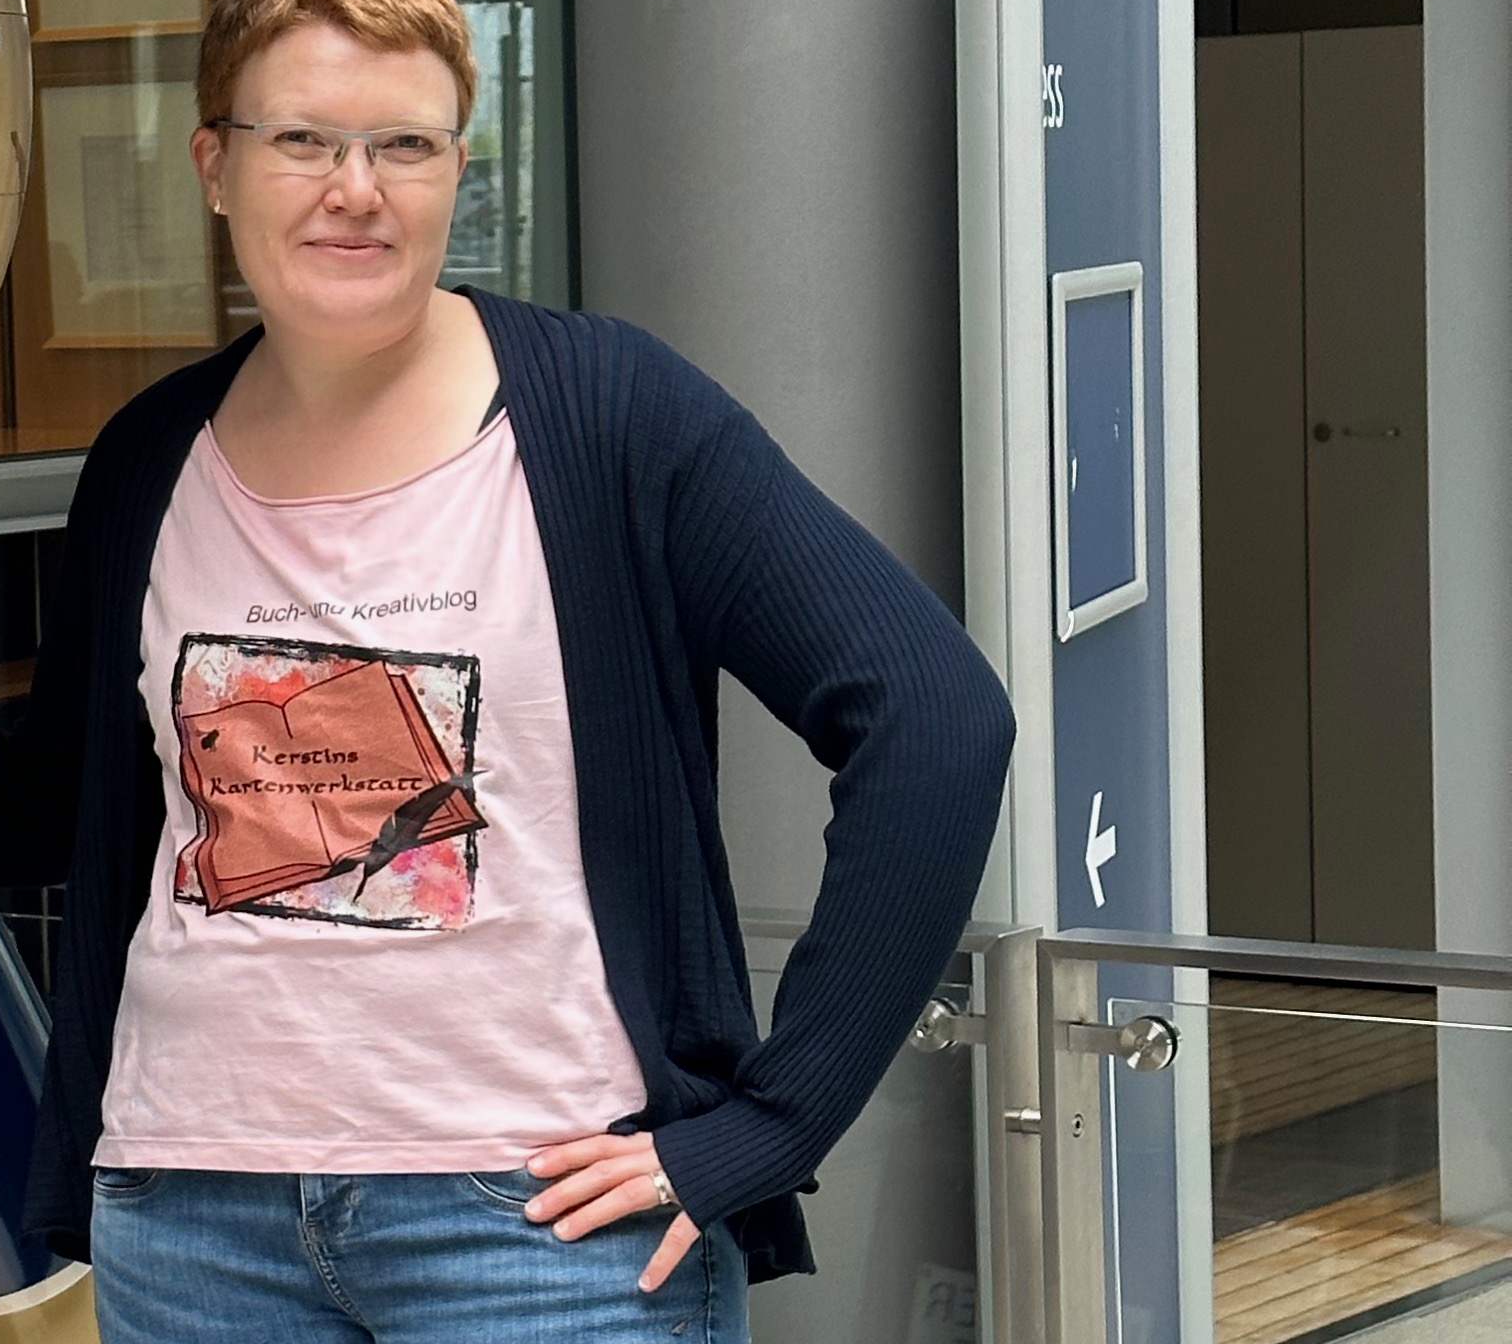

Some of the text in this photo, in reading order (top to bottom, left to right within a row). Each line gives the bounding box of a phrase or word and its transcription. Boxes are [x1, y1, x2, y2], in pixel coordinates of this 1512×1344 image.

[351, 589, 478, 621] Kreativblog
[252, 745, 359, 765] Kerstins
[210, 773, 424, 797] Kartenwerkstatt
